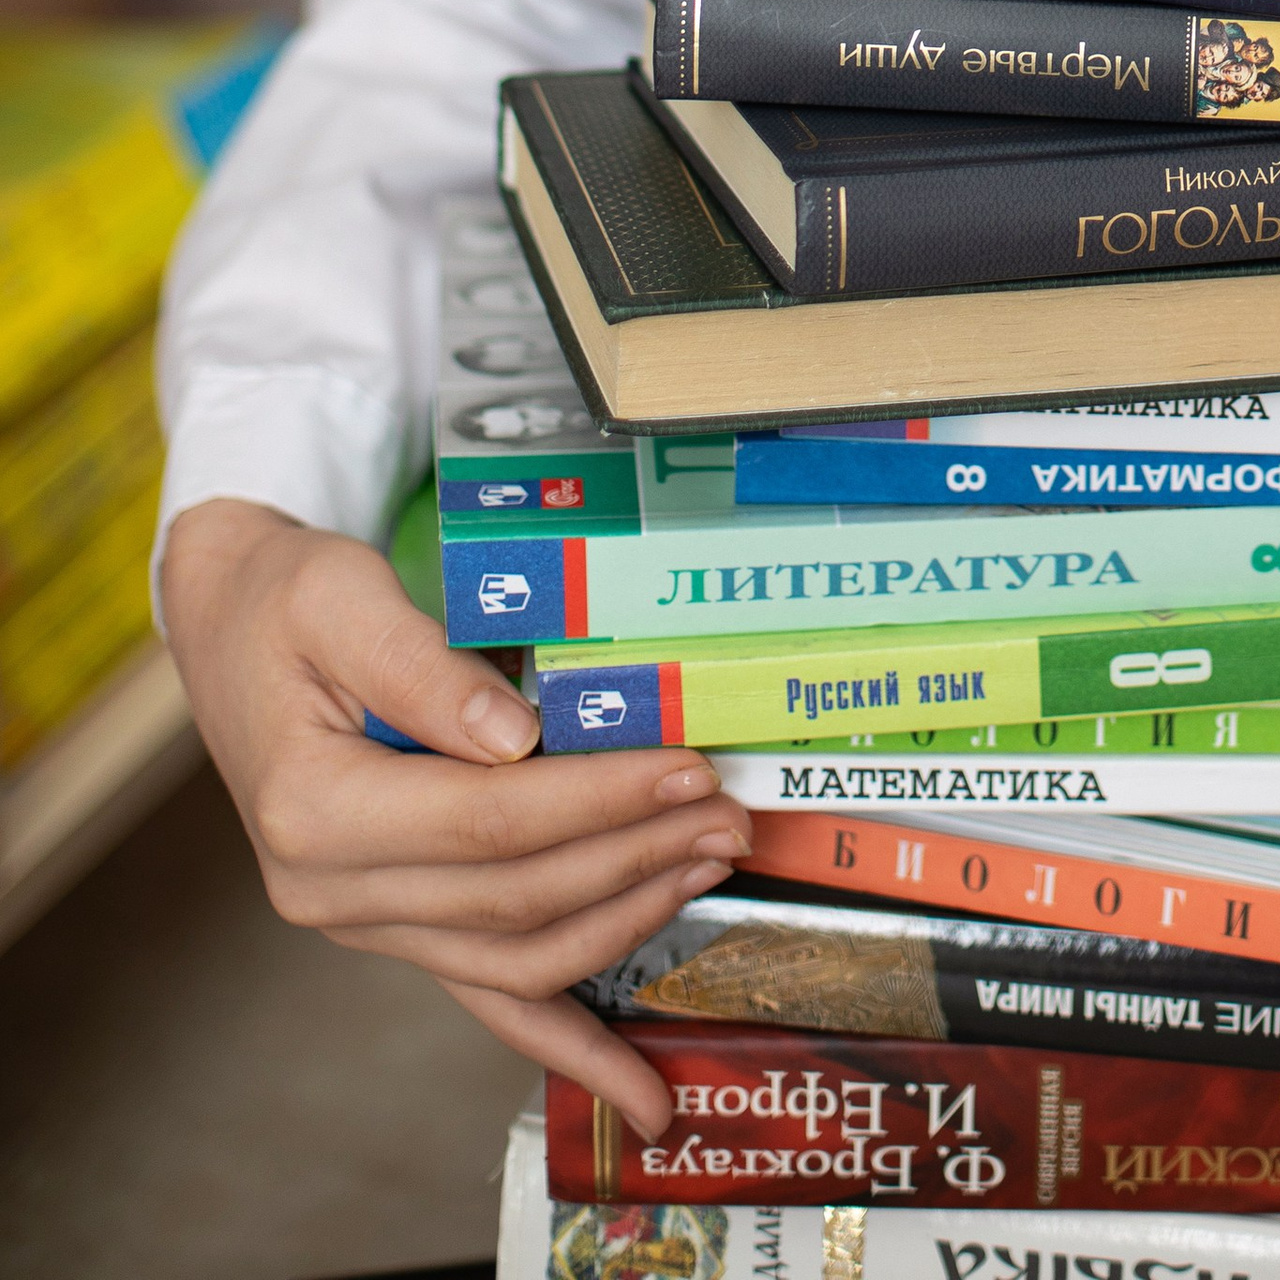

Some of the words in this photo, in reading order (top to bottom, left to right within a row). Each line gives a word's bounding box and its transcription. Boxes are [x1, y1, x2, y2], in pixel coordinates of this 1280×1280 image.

[840, 29, 945, 71] души
[961, 41, 1151, 92] Мертвые
[945, 462, 987, 493] 8
[656, 549, 1139, 607] ЛИТЕРАТУРА
[786, 671, 900, 720] Русский
[918, 670, 986, 704] язык
[1109, 647, 1213, 688] 8
[779, 766, 1108, 802] МАТЕМАТИКА
[975, 978, 1075, 1019] МИРА
[1083, 989, 1205, 1032] ТАЙНЫ
[672, 1069, 890, 1141] Ефрон
[905, 1082, 982, 1139] И.
[640, 1133, 920, 1198] Брокгауз
[936, 1144, 1007, 1197] Ф.
